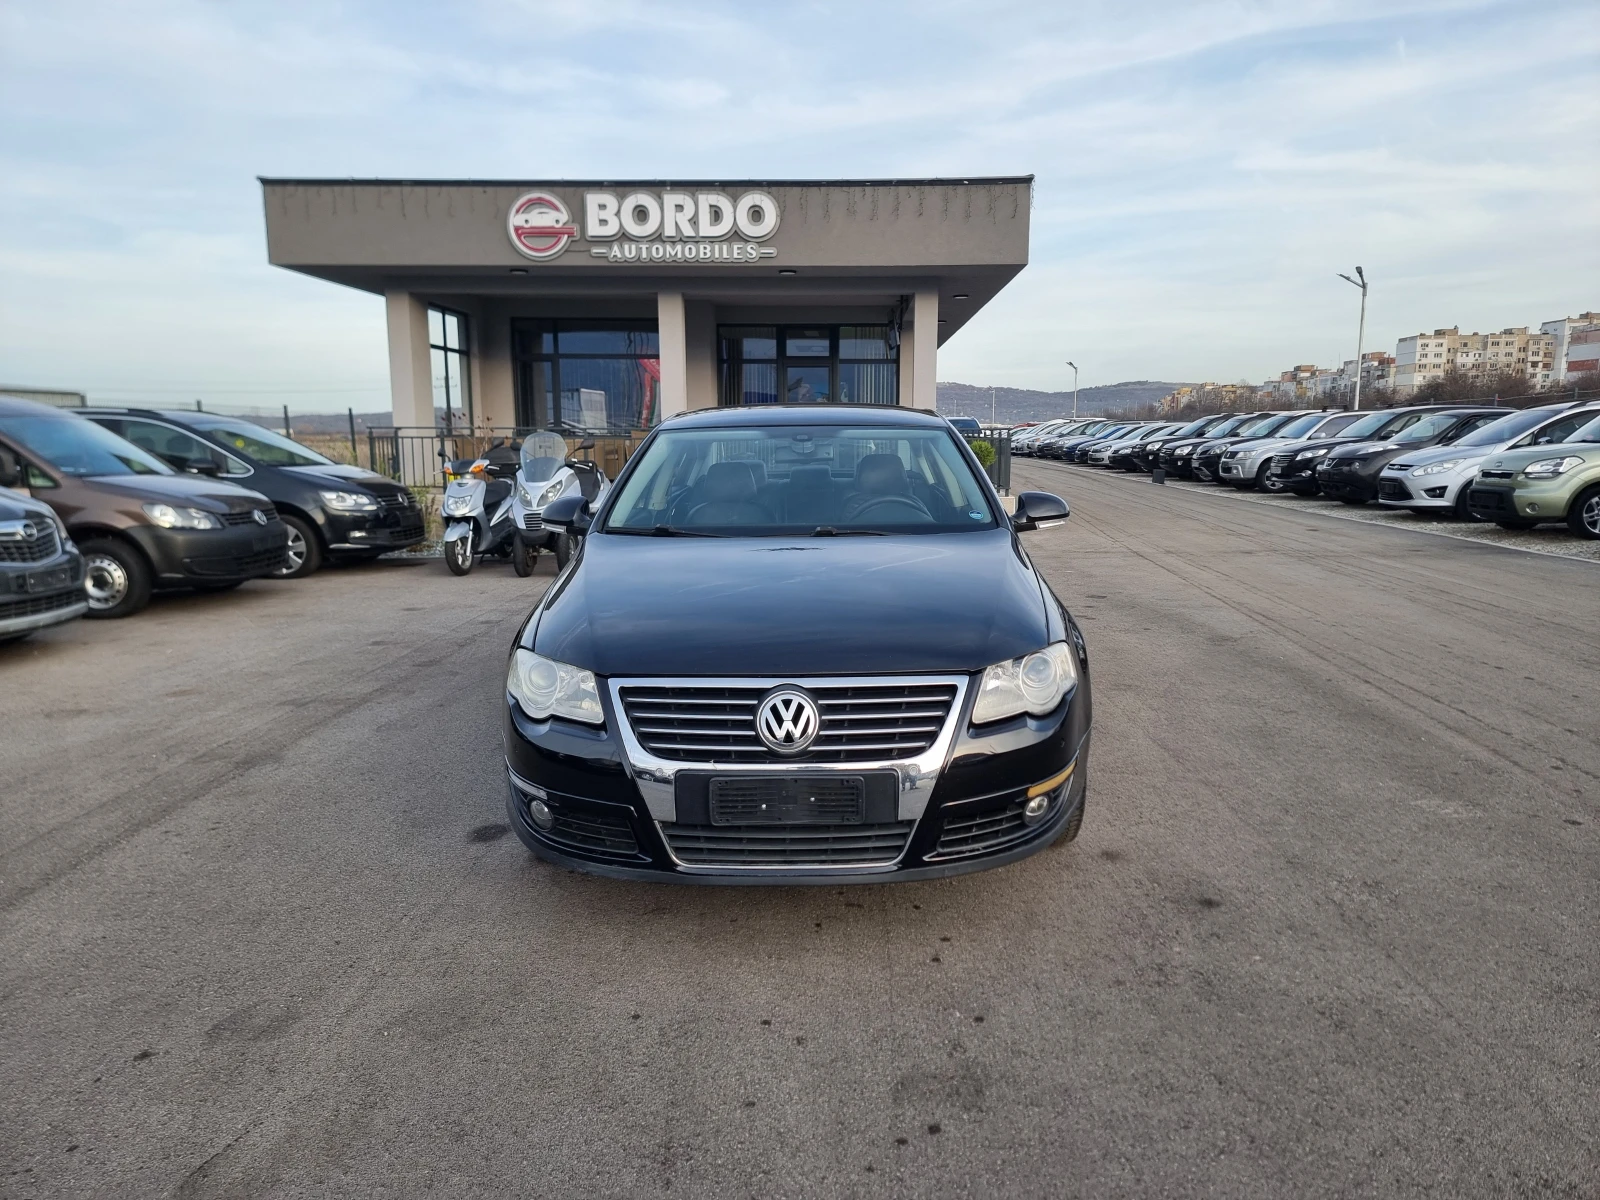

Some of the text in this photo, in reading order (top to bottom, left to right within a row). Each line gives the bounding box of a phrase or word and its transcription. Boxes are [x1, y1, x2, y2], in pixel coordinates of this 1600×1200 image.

[585, 193, 777, 238] BORDO
[610, 244, 757, 259] AUTOMOBILES
[760, 693, 815, 748] VW
